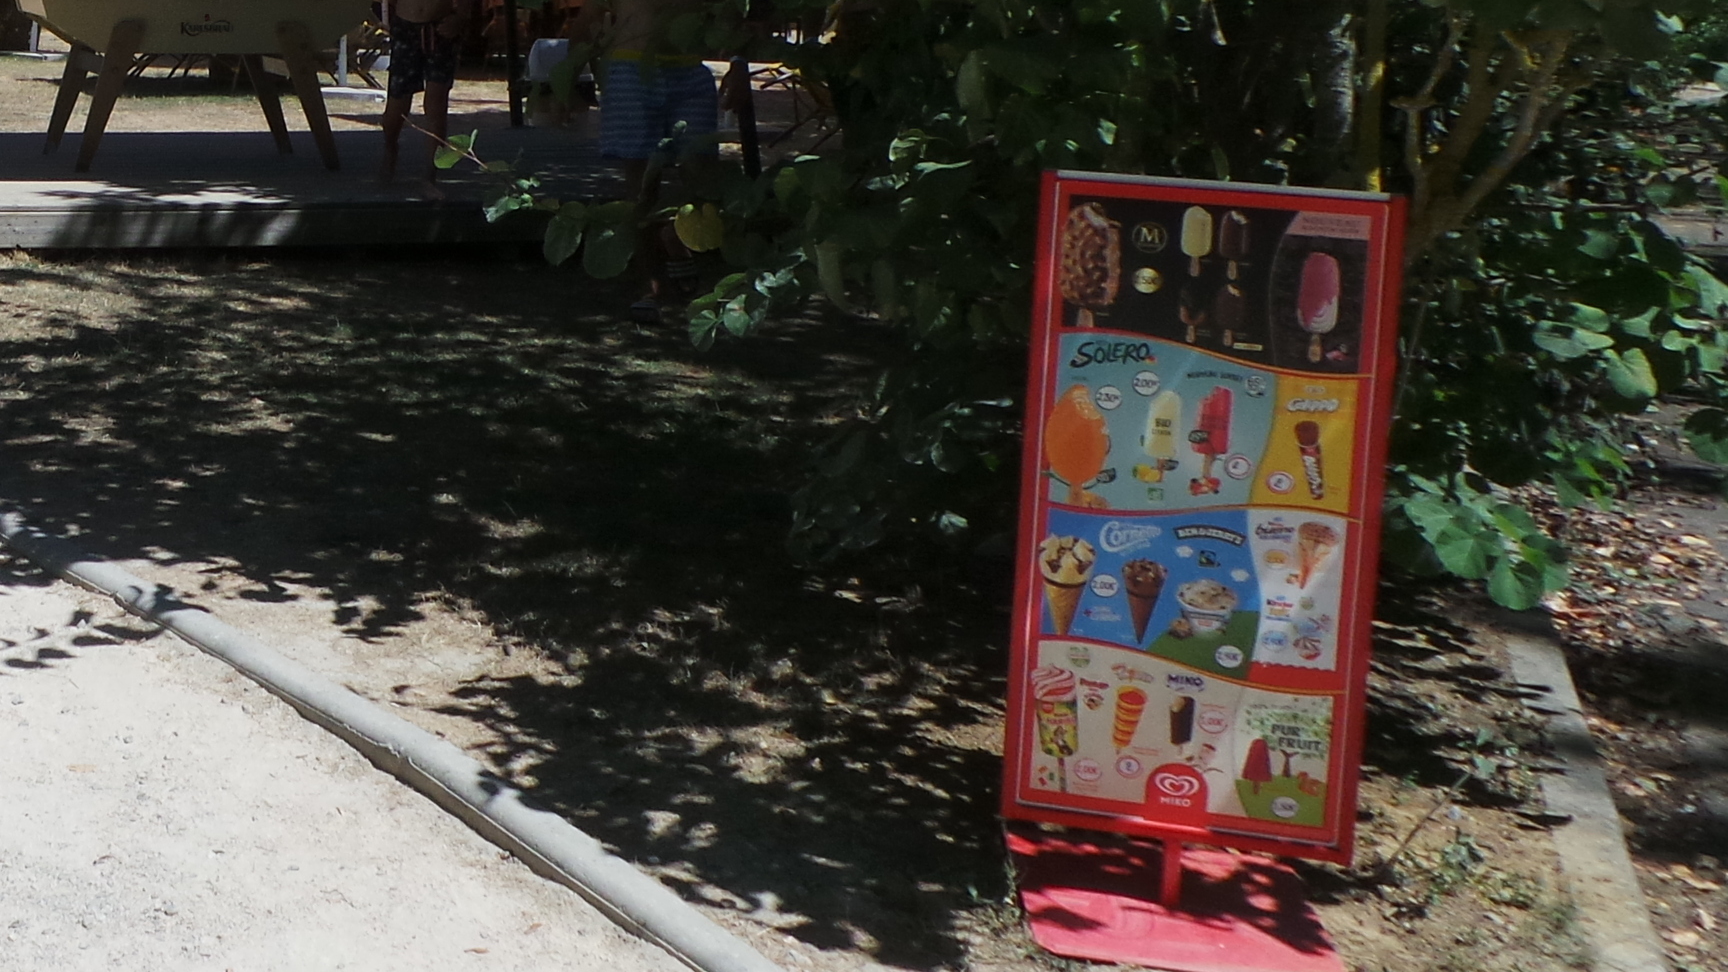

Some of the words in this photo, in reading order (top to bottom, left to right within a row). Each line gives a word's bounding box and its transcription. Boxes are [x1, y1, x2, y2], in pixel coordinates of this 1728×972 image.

[1140, 226, 1160, 244] M
[1070, 341, 1150, 368] SOLERO
[1166, 674, 1204, 688] MIKO
[1271, 724, 1302, 737] PUR
[1278, 736, 1322, 751] FRUIT
[1160, 797, 1192, 808] MIKO
